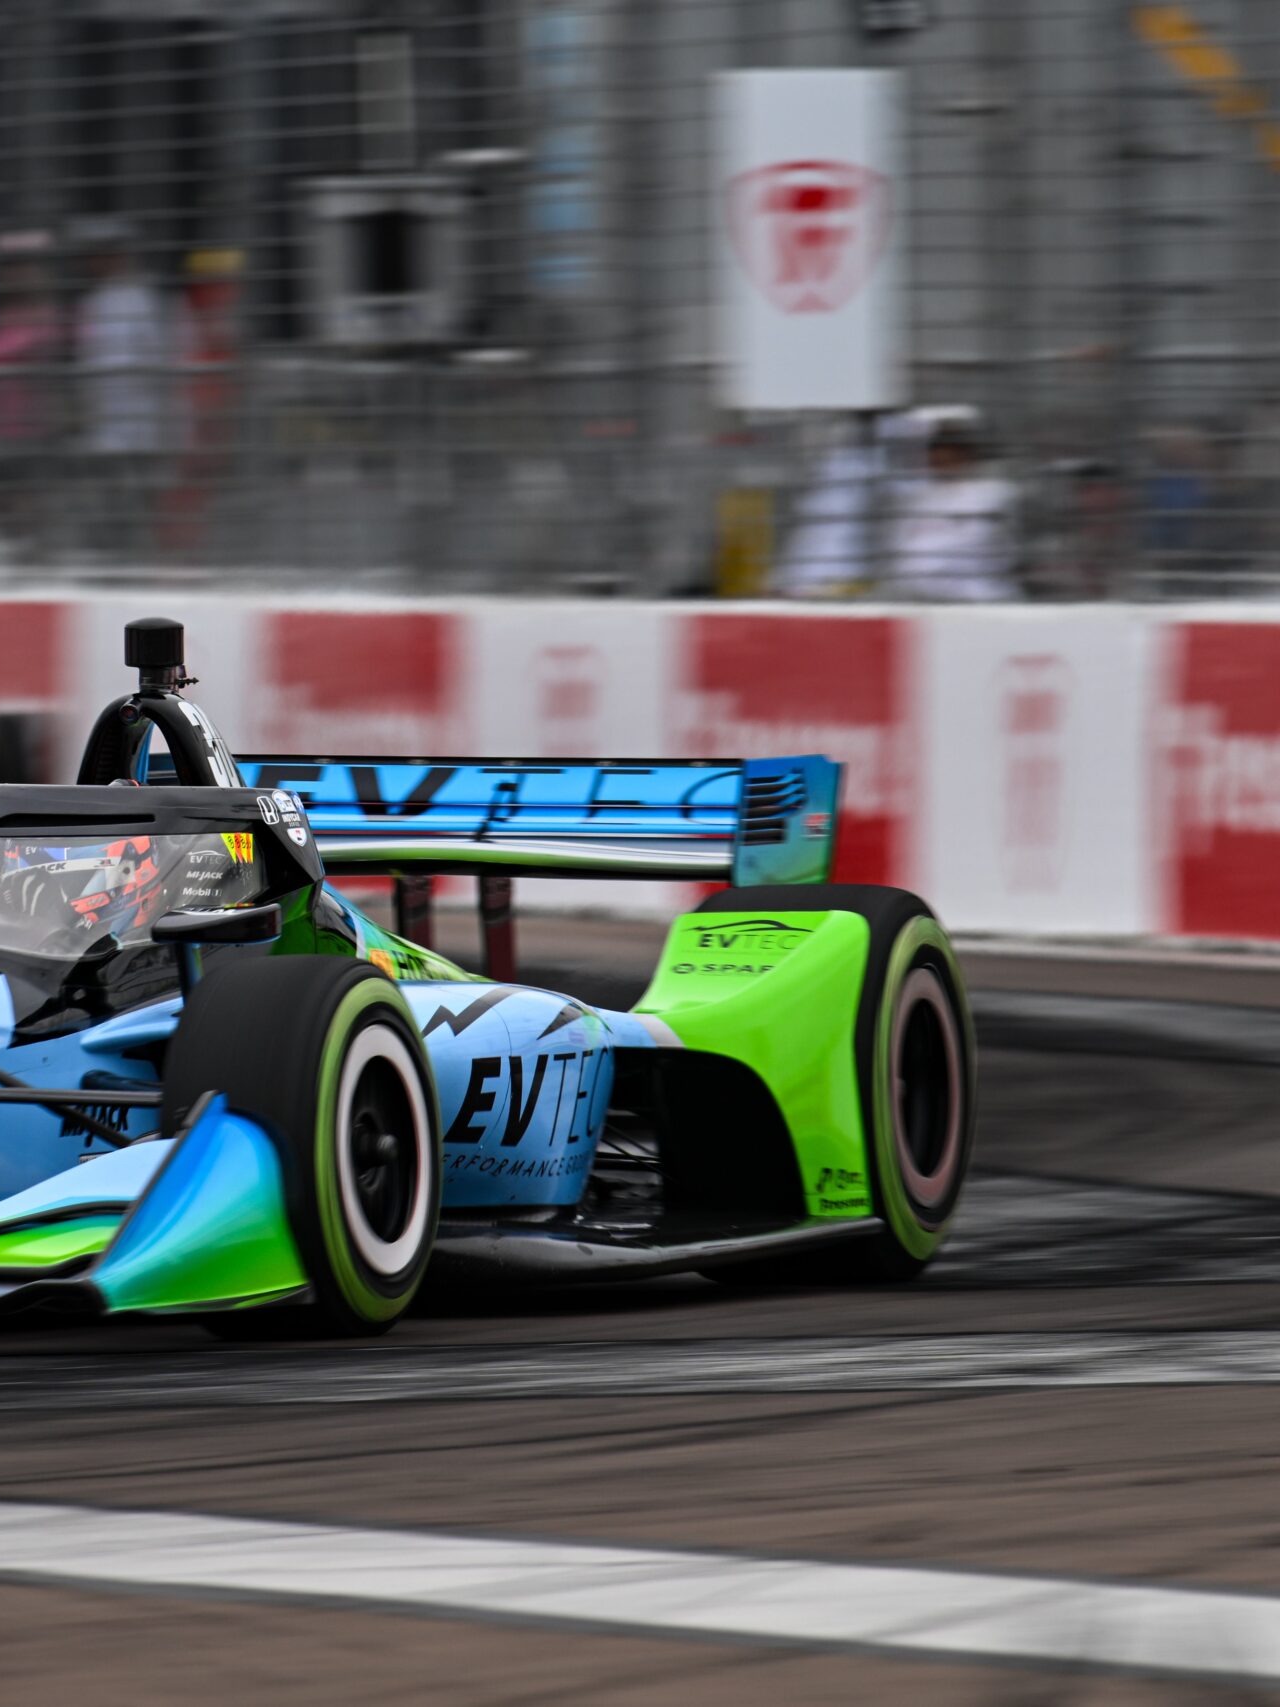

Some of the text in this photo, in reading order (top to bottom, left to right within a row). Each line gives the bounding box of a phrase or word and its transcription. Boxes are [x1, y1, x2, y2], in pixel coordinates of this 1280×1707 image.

[185, 870, 224, 881] MI-JACK
[182, 887, 211, 897] Mobil
[697, 933, 799, 950] EVTEC
